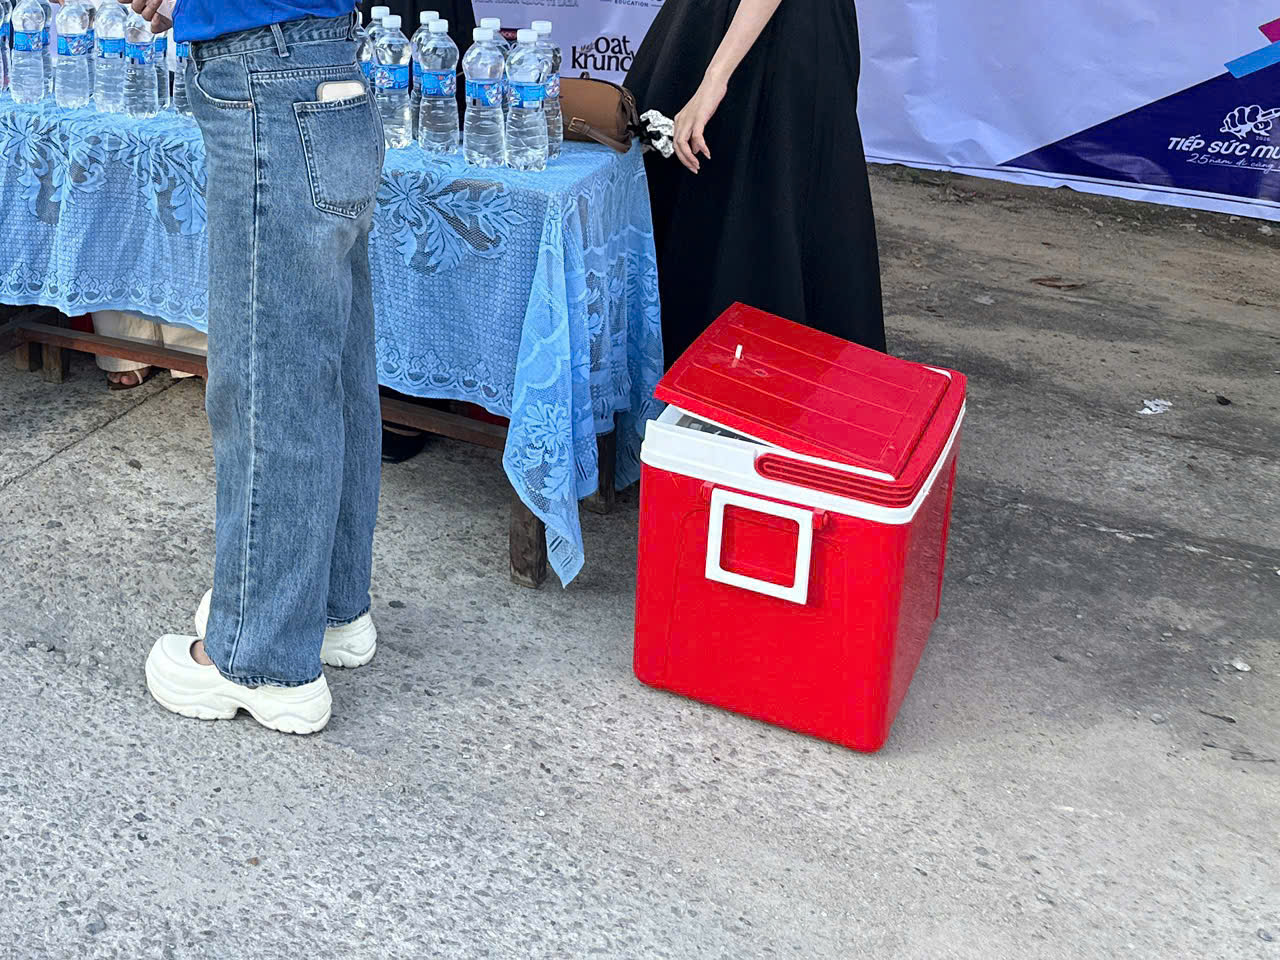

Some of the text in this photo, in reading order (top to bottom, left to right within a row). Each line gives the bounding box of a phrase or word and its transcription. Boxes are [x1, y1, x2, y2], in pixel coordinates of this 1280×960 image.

[614, 0, 649, 7] EDUCATION
[595, 35, 630, 55] oat
[571, 45, 635, 72] krunc
[1168, 134, 1205, 151] TIẾP
[1208, 139, 1250, 156] SỨC
